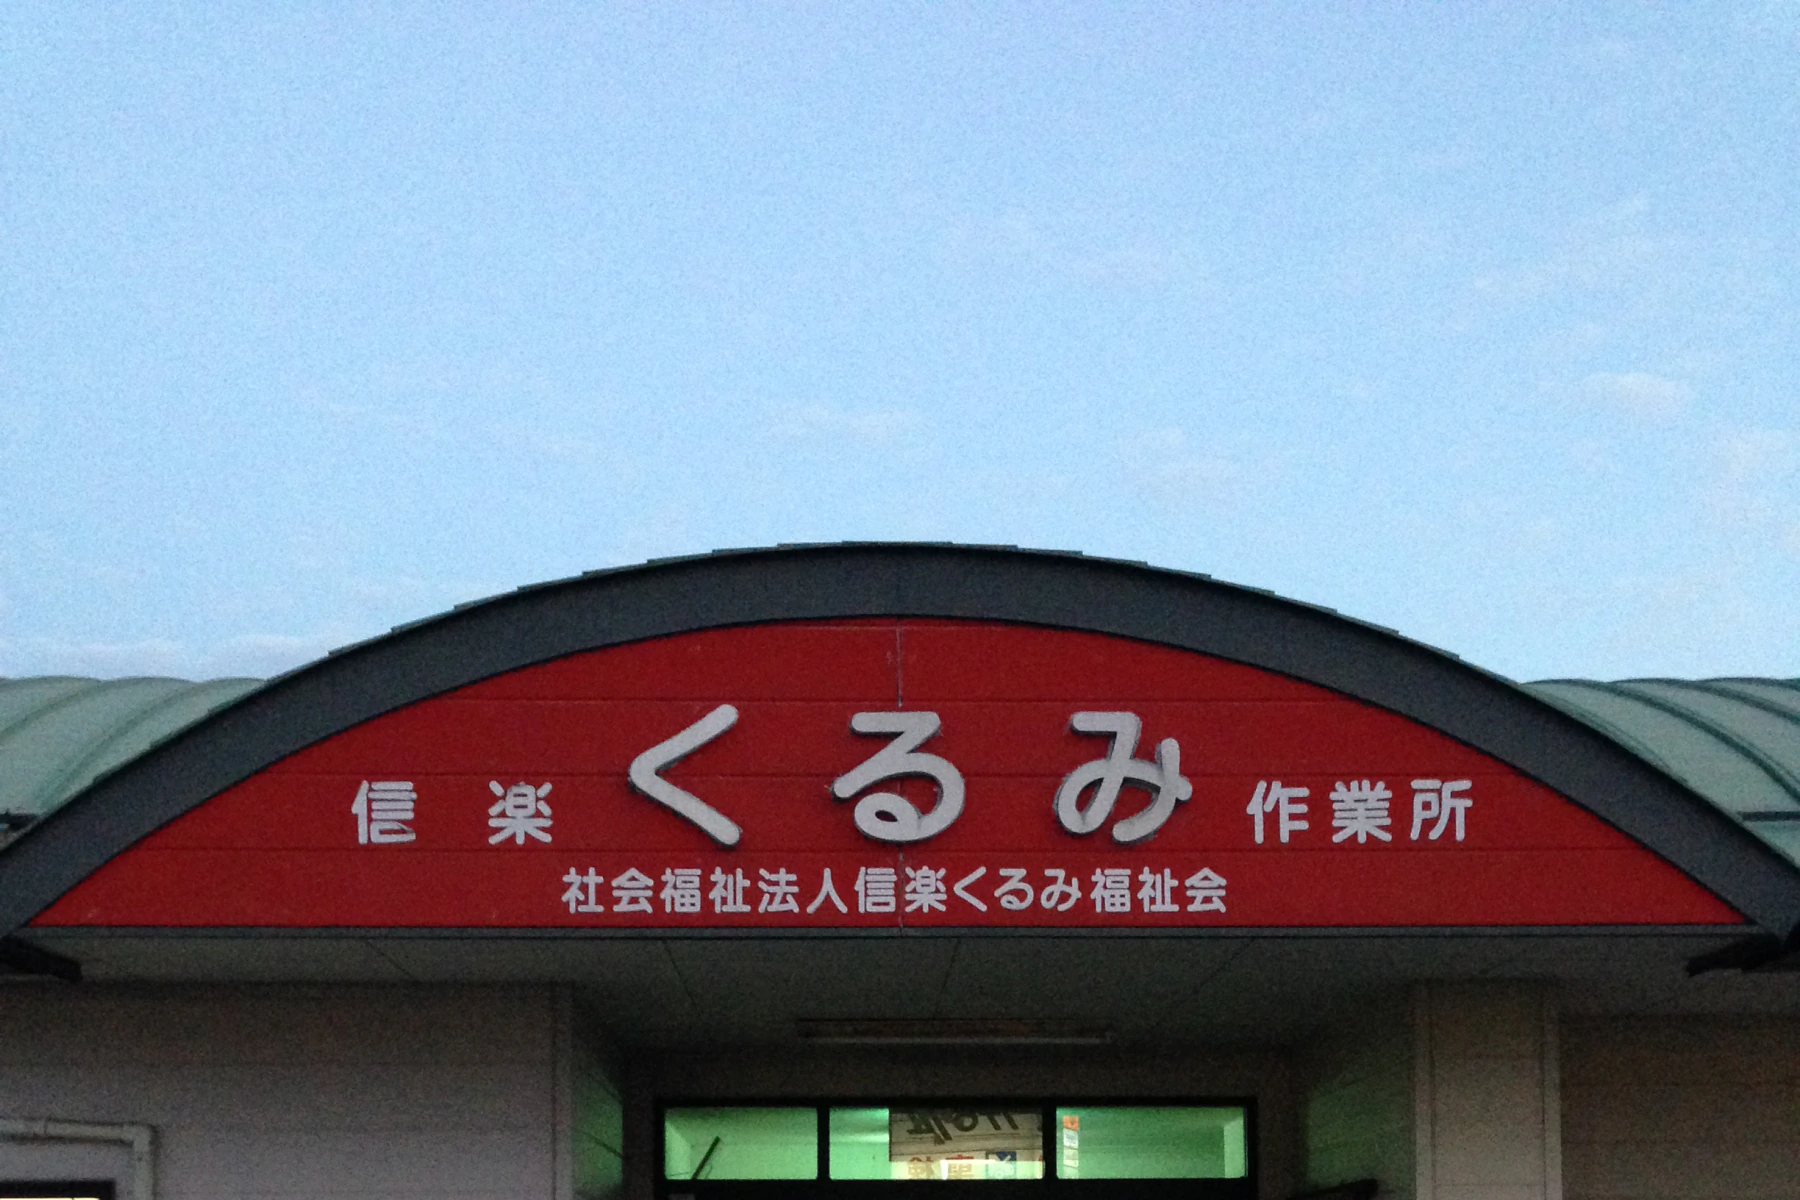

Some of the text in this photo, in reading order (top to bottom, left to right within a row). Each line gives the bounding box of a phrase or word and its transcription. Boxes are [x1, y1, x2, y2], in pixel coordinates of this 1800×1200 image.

[349, 703, 1474, 846] 信楽 くるみ 作業所
[561, 866, 1227, 915] 社会福祉法人信楽くるみ福祉会
